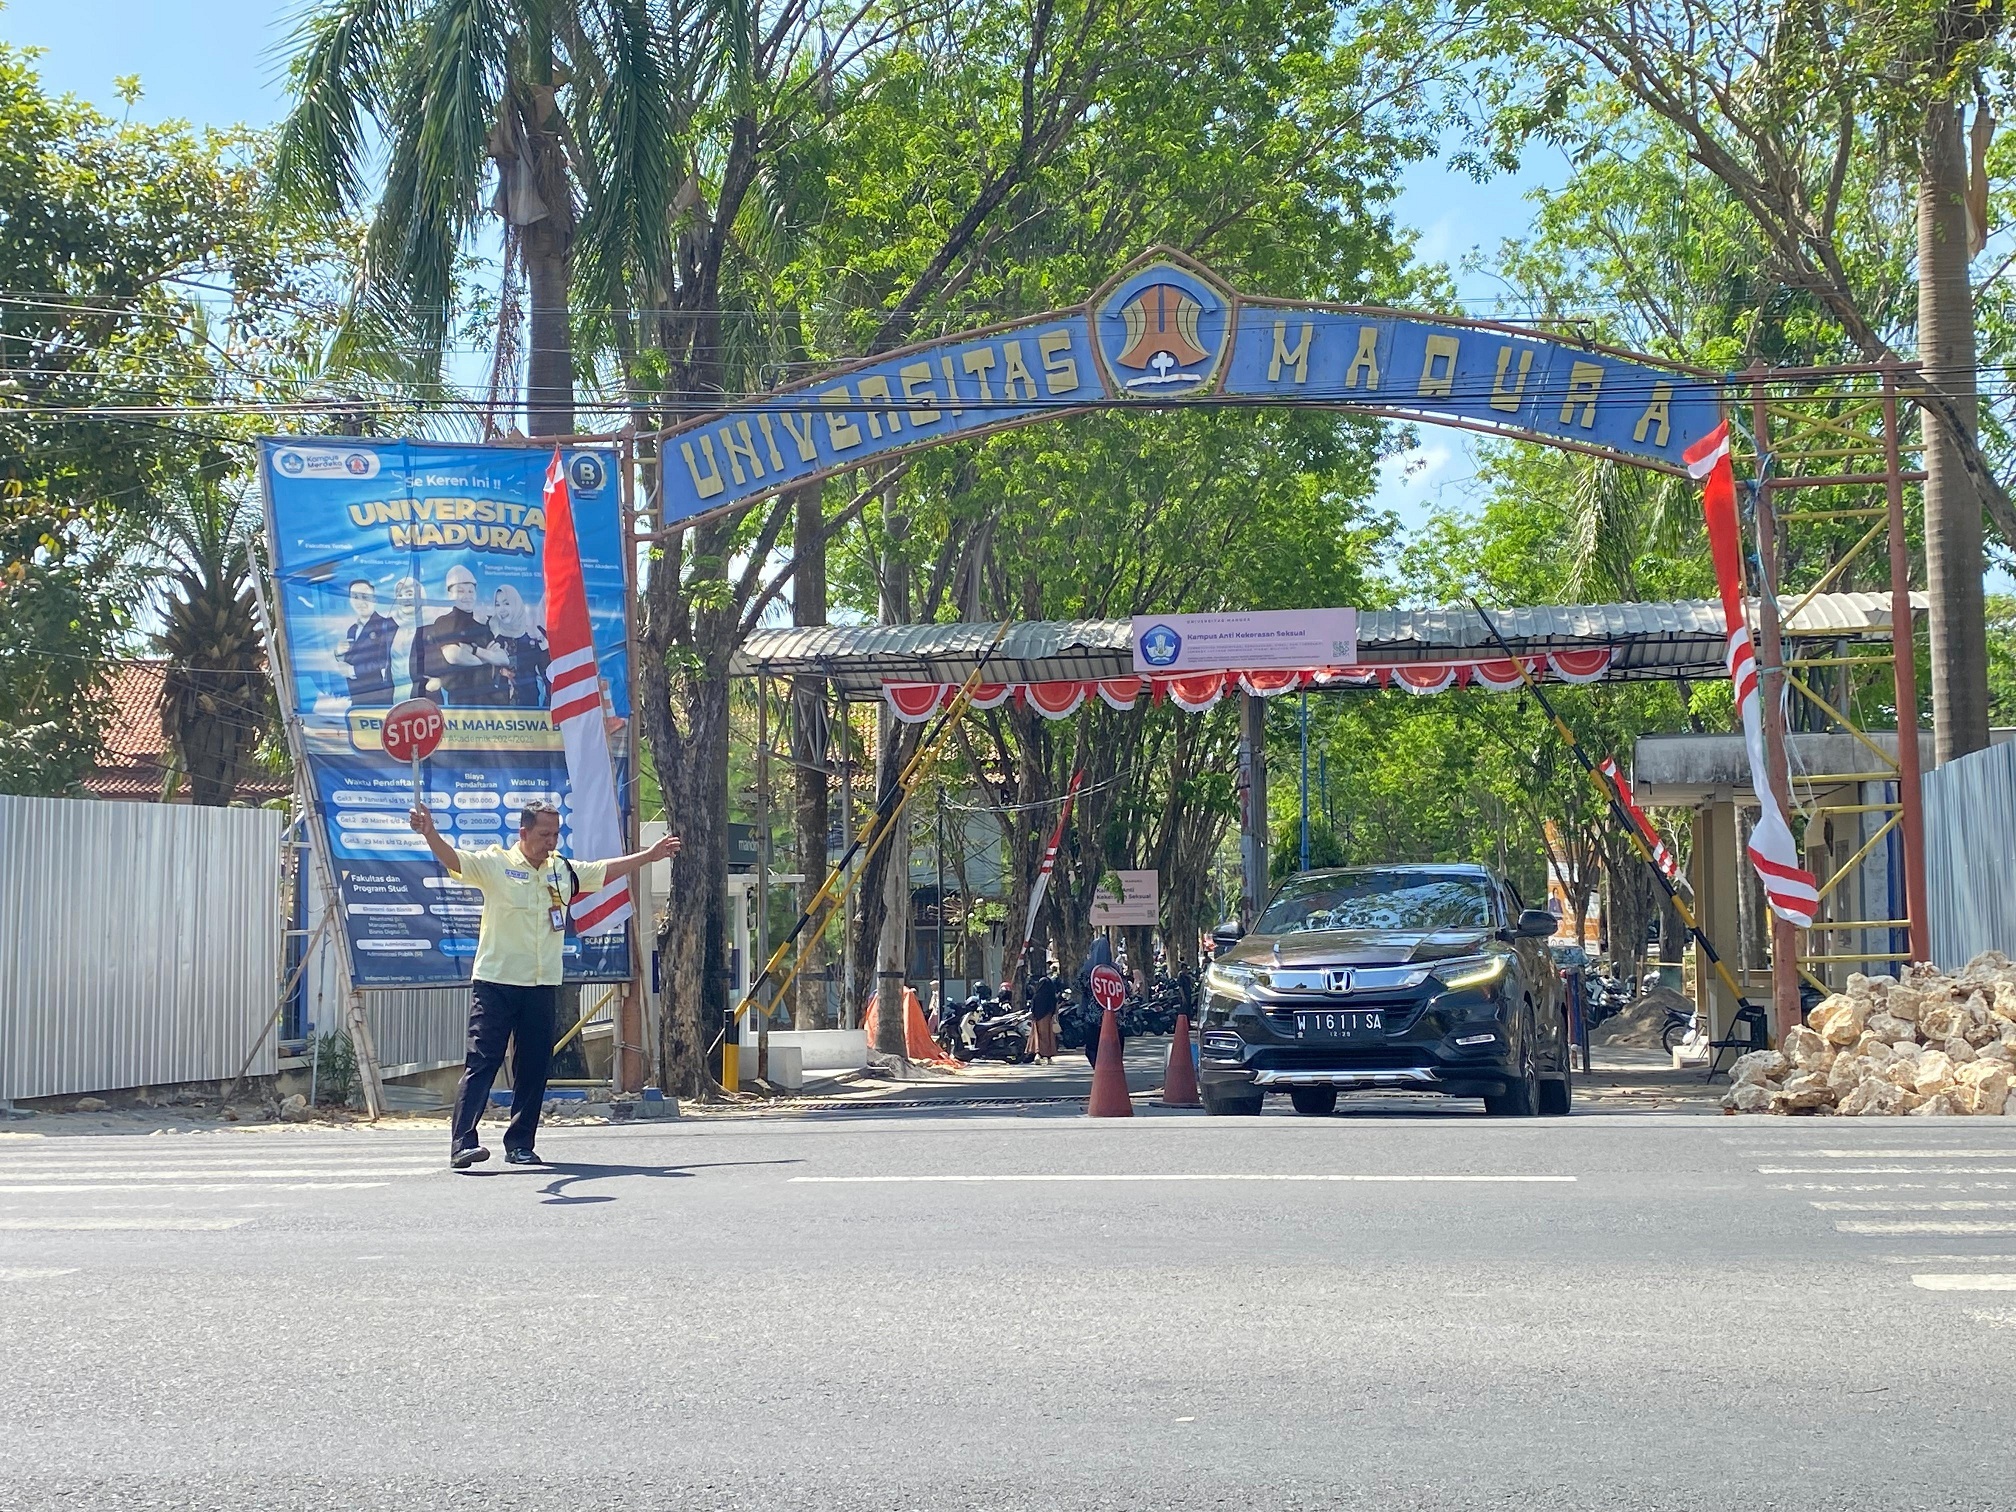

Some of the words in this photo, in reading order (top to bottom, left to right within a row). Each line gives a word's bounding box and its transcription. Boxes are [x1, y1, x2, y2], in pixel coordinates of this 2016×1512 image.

[680, 328, 1079, 499] UNIVERSITAS
[1267, 319, 1674, 457] MADURA
[306, 454, 340, 463] Kampus
[580, 463, 595, 480] B
[426, 474, 468, 487] Keren
[472, 476, 490, 488] Ini
[348, 498, 546, 531] UNIVERSITA
[391, 523, 534, 554] MADURA
[386, 714, 441, 747] STOP
[462, 719, 549, 732] MAHASISWA
[493, 735, 534, 744] 2024/2025
[344, 778, 372, 786] Waktu
[510, 778, 536, 786] Waktu
[351, 874, 385, 883] Fakultas
[386, 874, 401, 883] dan
[353, 884, 387, 894] Program
[388, 884, 408, 893] Studi
[1094, 976, 1122, 998] STOP
[1296, 1015, 1306, 1030] W
[1315, 1014, 1357, 1030] 1611
[1366, 1014, 1382, 1029] SA
